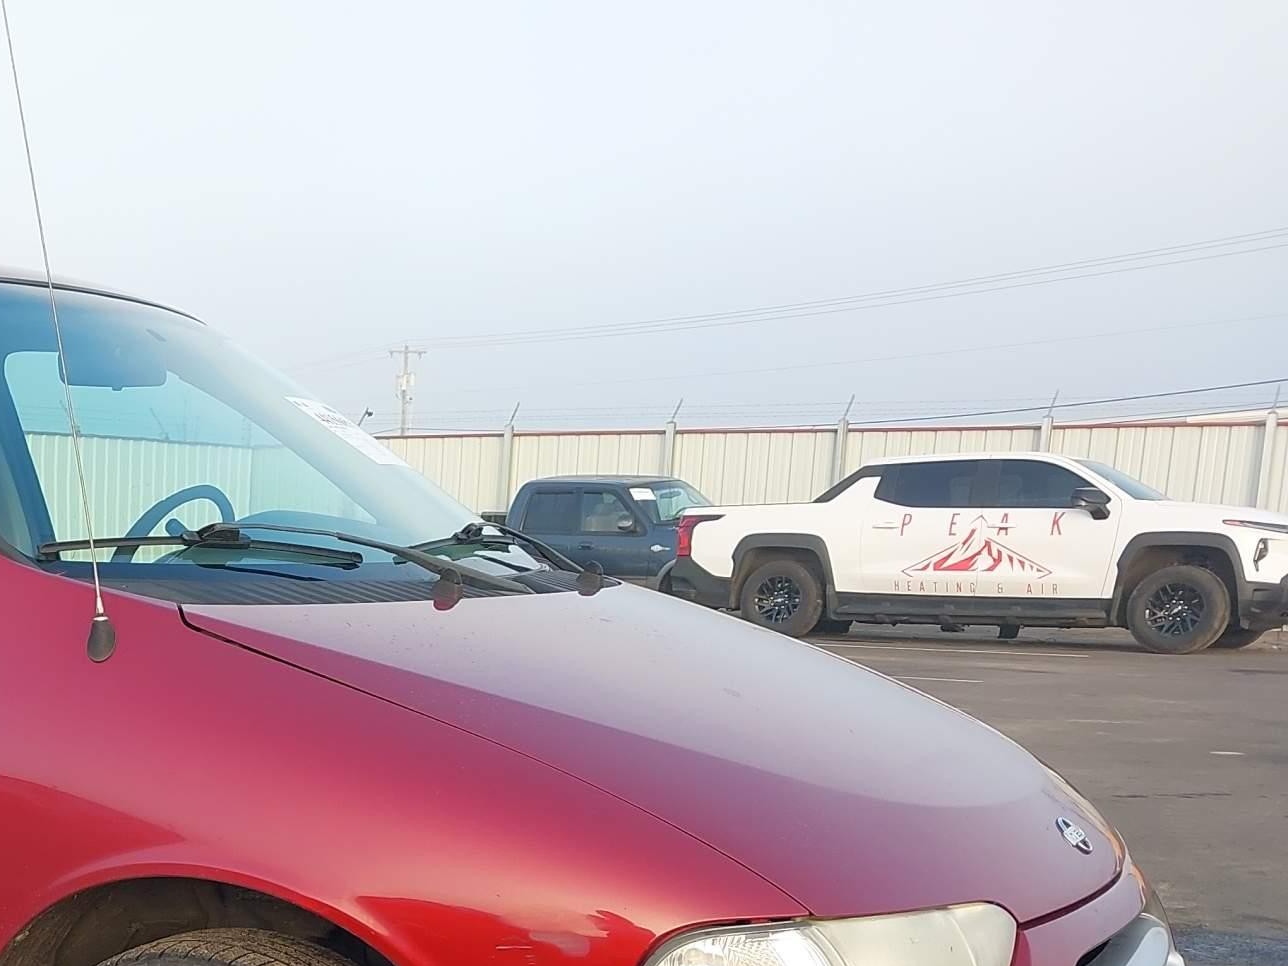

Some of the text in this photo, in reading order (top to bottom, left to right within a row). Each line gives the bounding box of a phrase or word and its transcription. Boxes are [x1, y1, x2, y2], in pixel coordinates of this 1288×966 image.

[900, 511, 1065, 536] PEAK
[893, 580, 1059, 595] HEATING & AIR
